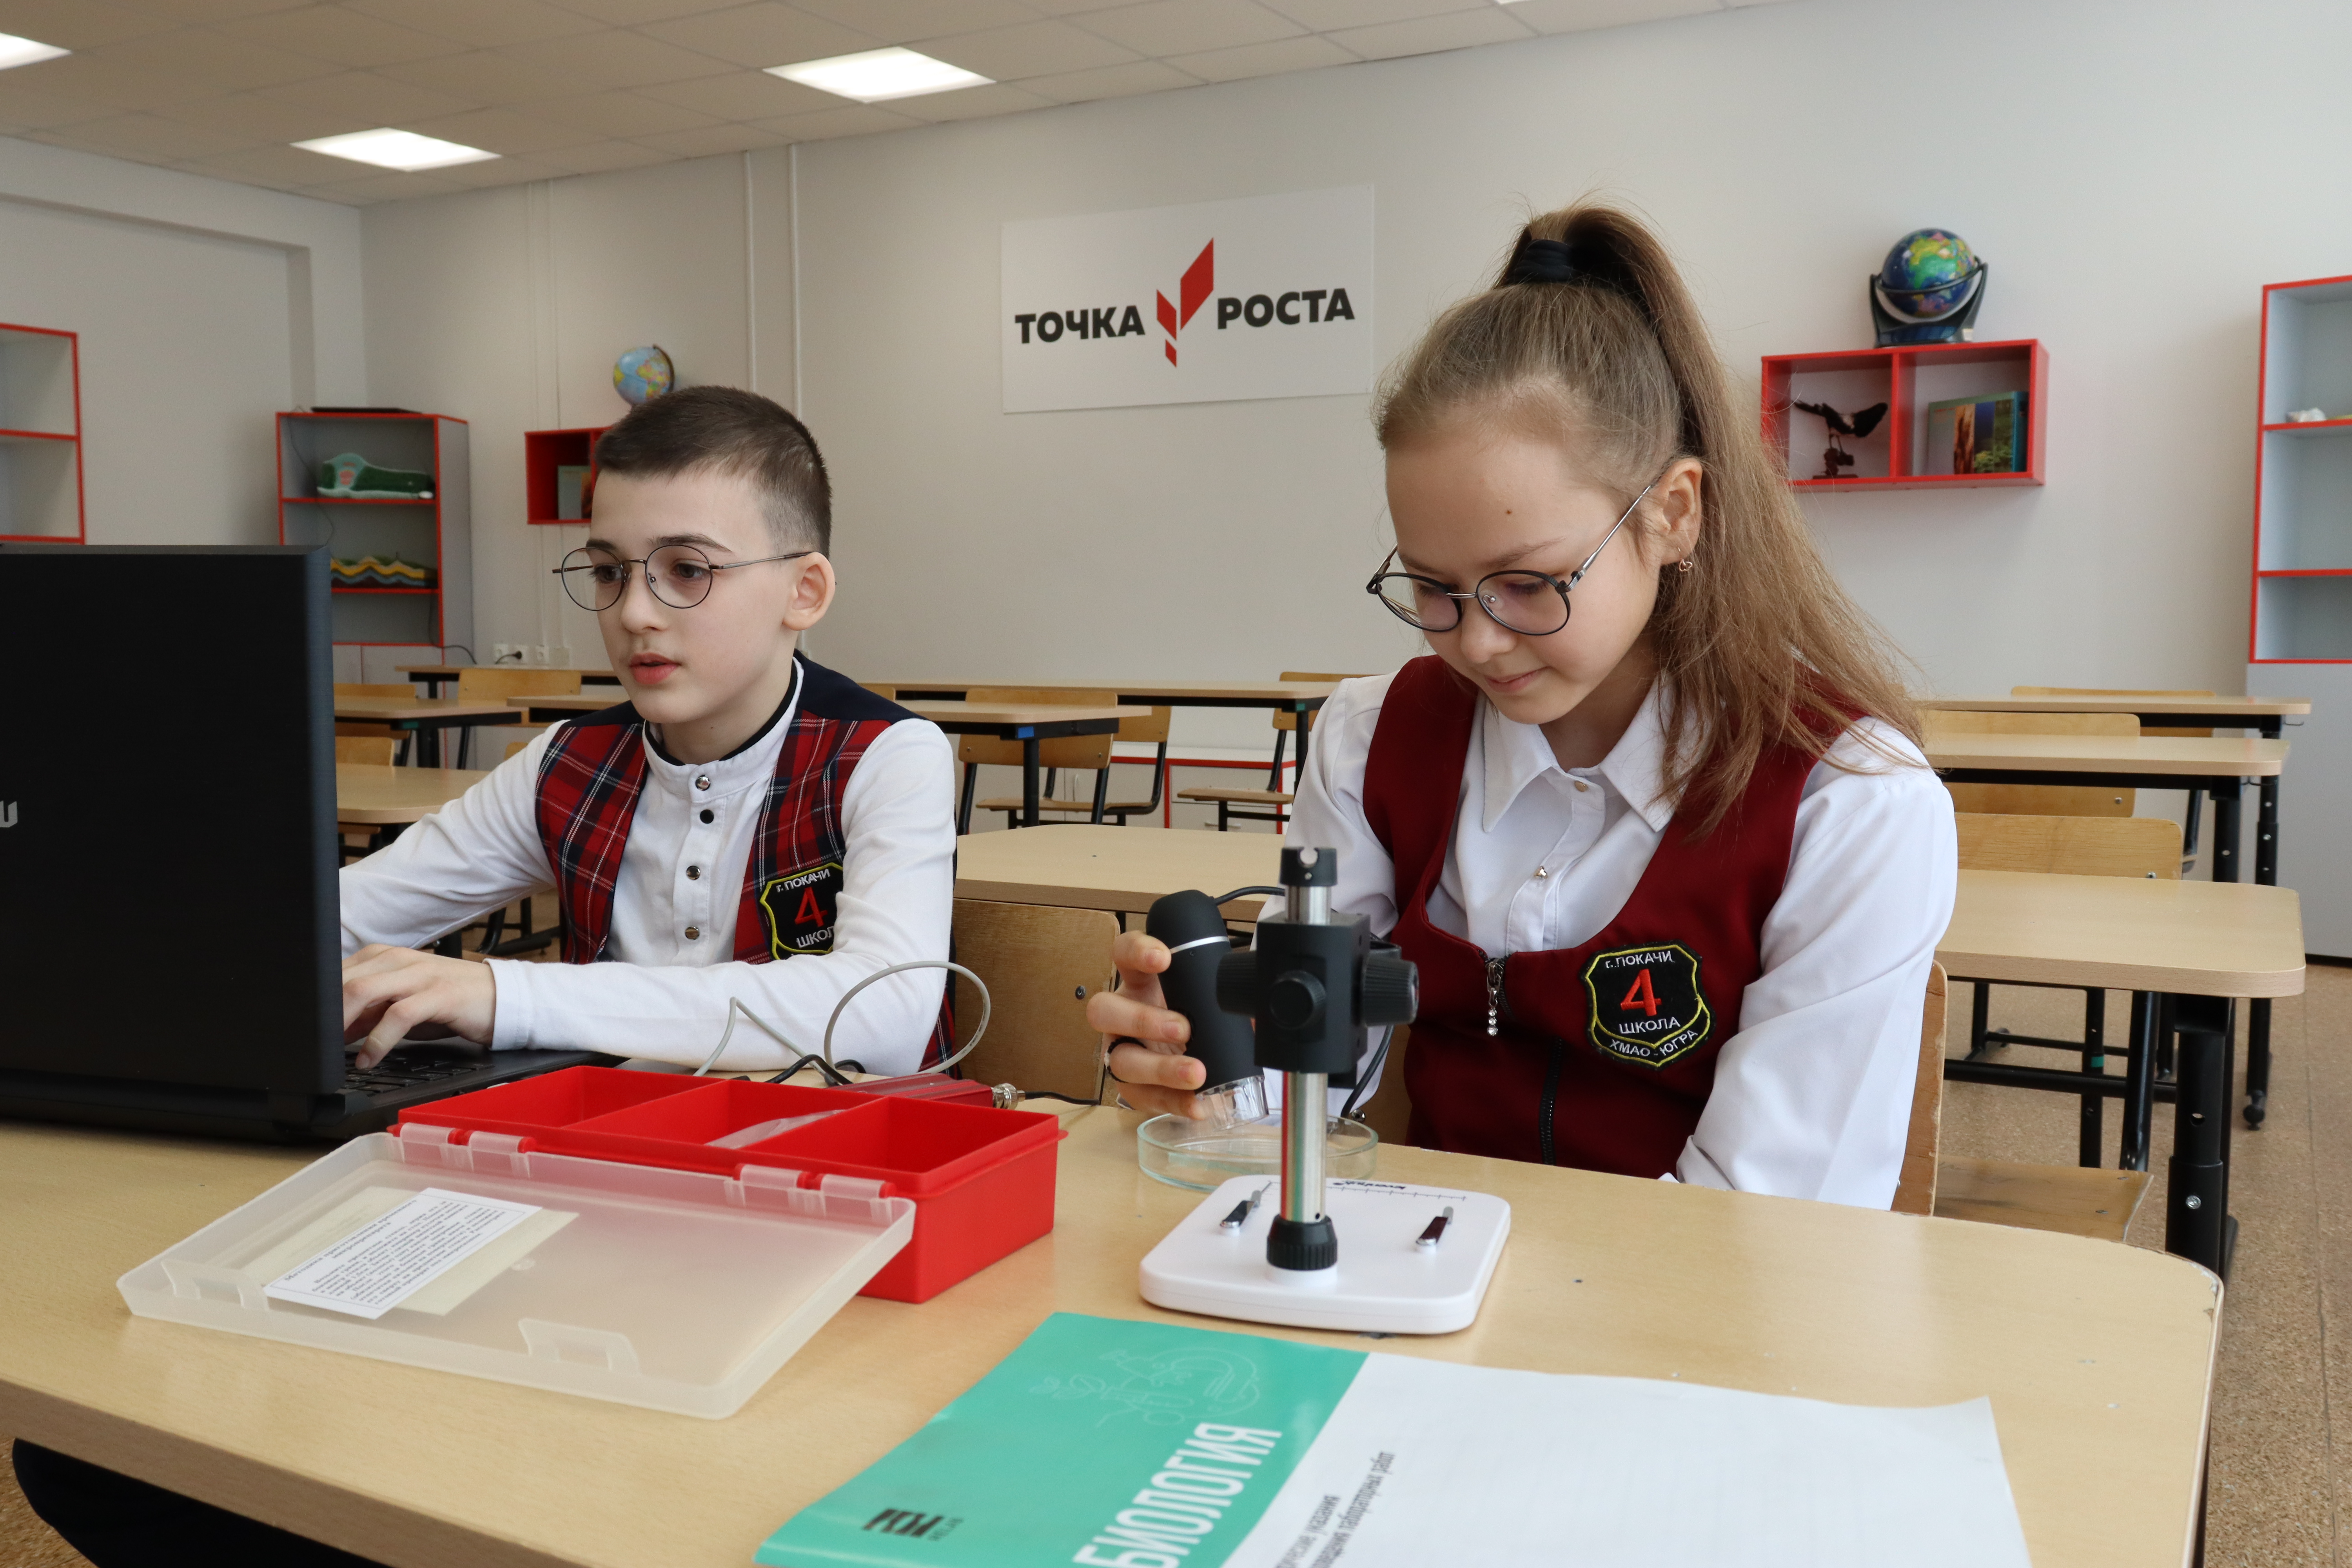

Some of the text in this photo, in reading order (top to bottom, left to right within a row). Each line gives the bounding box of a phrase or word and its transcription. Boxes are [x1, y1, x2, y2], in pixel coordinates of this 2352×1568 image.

[1015, 288, 1355, 344] ТОЧКА РОСТА
[795, 886, 828, 927] 4
[796, 926, 834, 948] ШКОЛ
[1620, 969, 1662, 1016] 4
[1619, 1016, 1681, 1034] ШКОЛА
[1072, 1422, 1283, 1568] БИОЛОГИЯ
